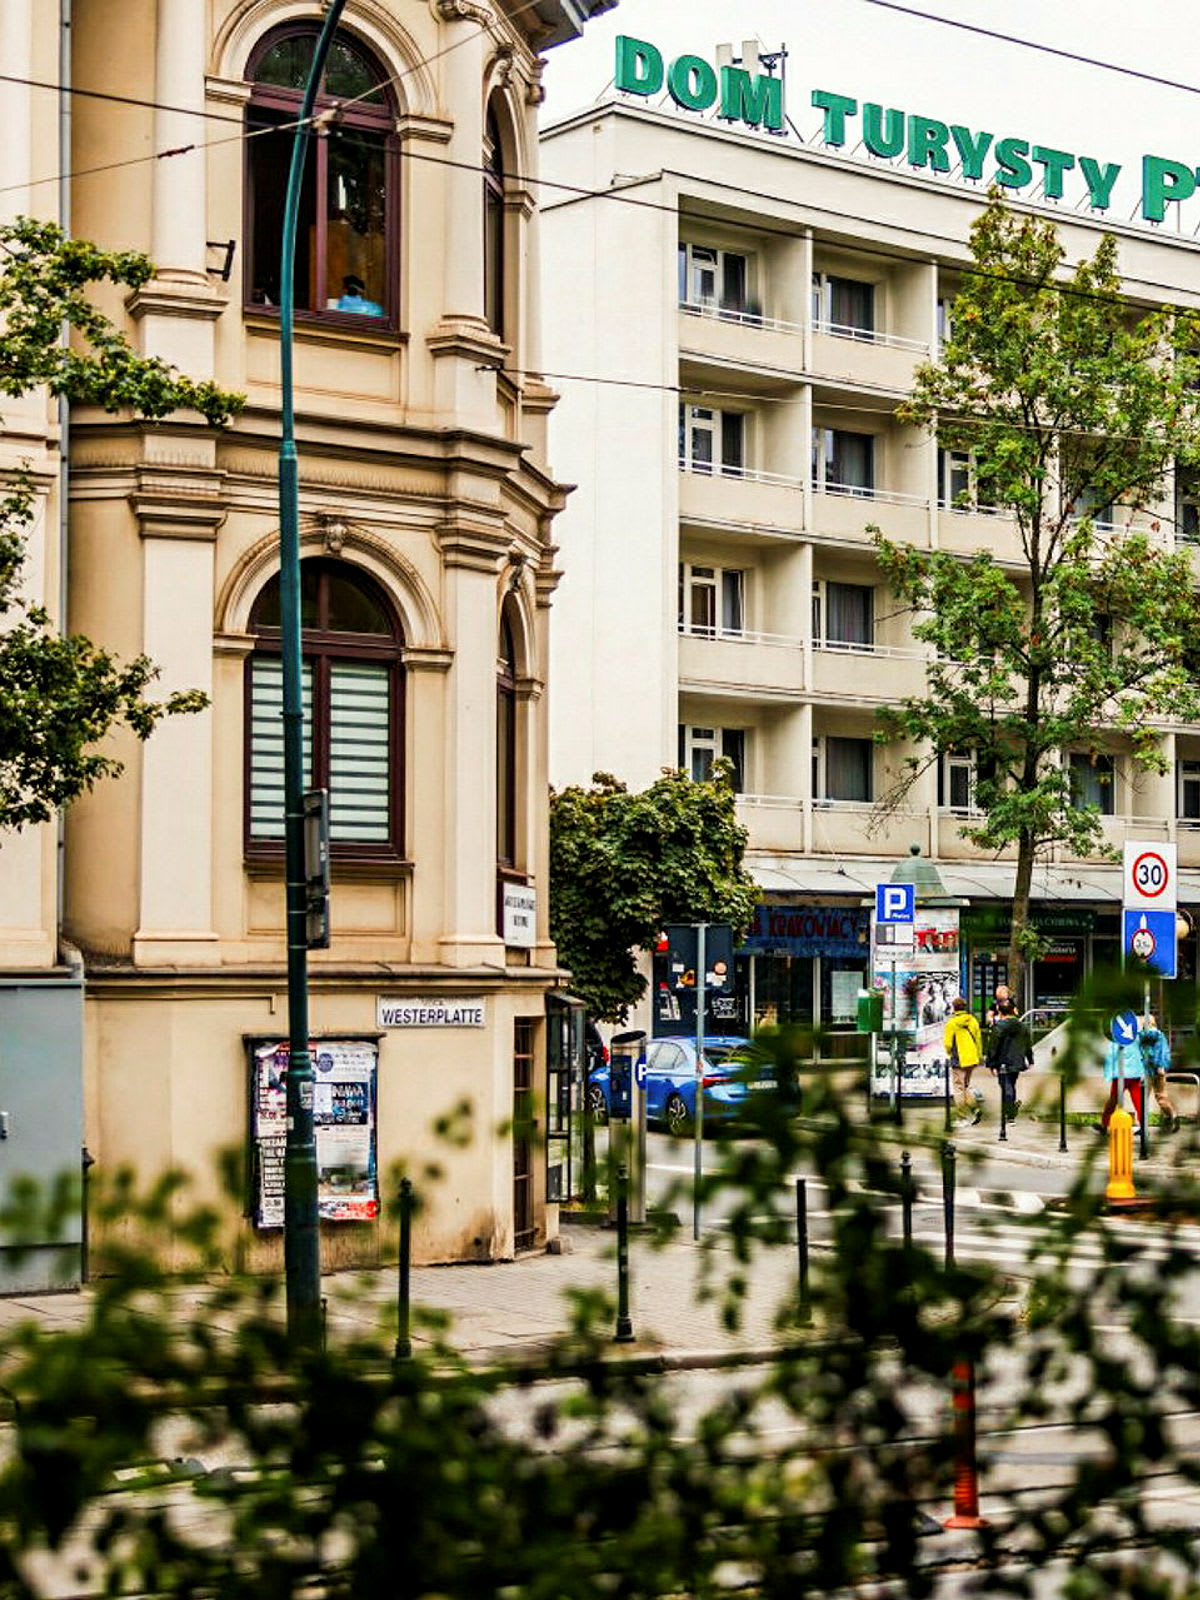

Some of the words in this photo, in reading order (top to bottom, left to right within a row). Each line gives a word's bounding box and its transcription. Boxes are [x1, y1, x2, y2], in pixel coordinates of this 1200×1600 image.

[614, 35, 782, 131] DOM
[811, 88, 1121, 210] TURYSTY
[1138, 864, 1162, 886] 30
[884, 887, 906, 919] P
[382, 1008, 482, 1024] WESTERPLATTE
